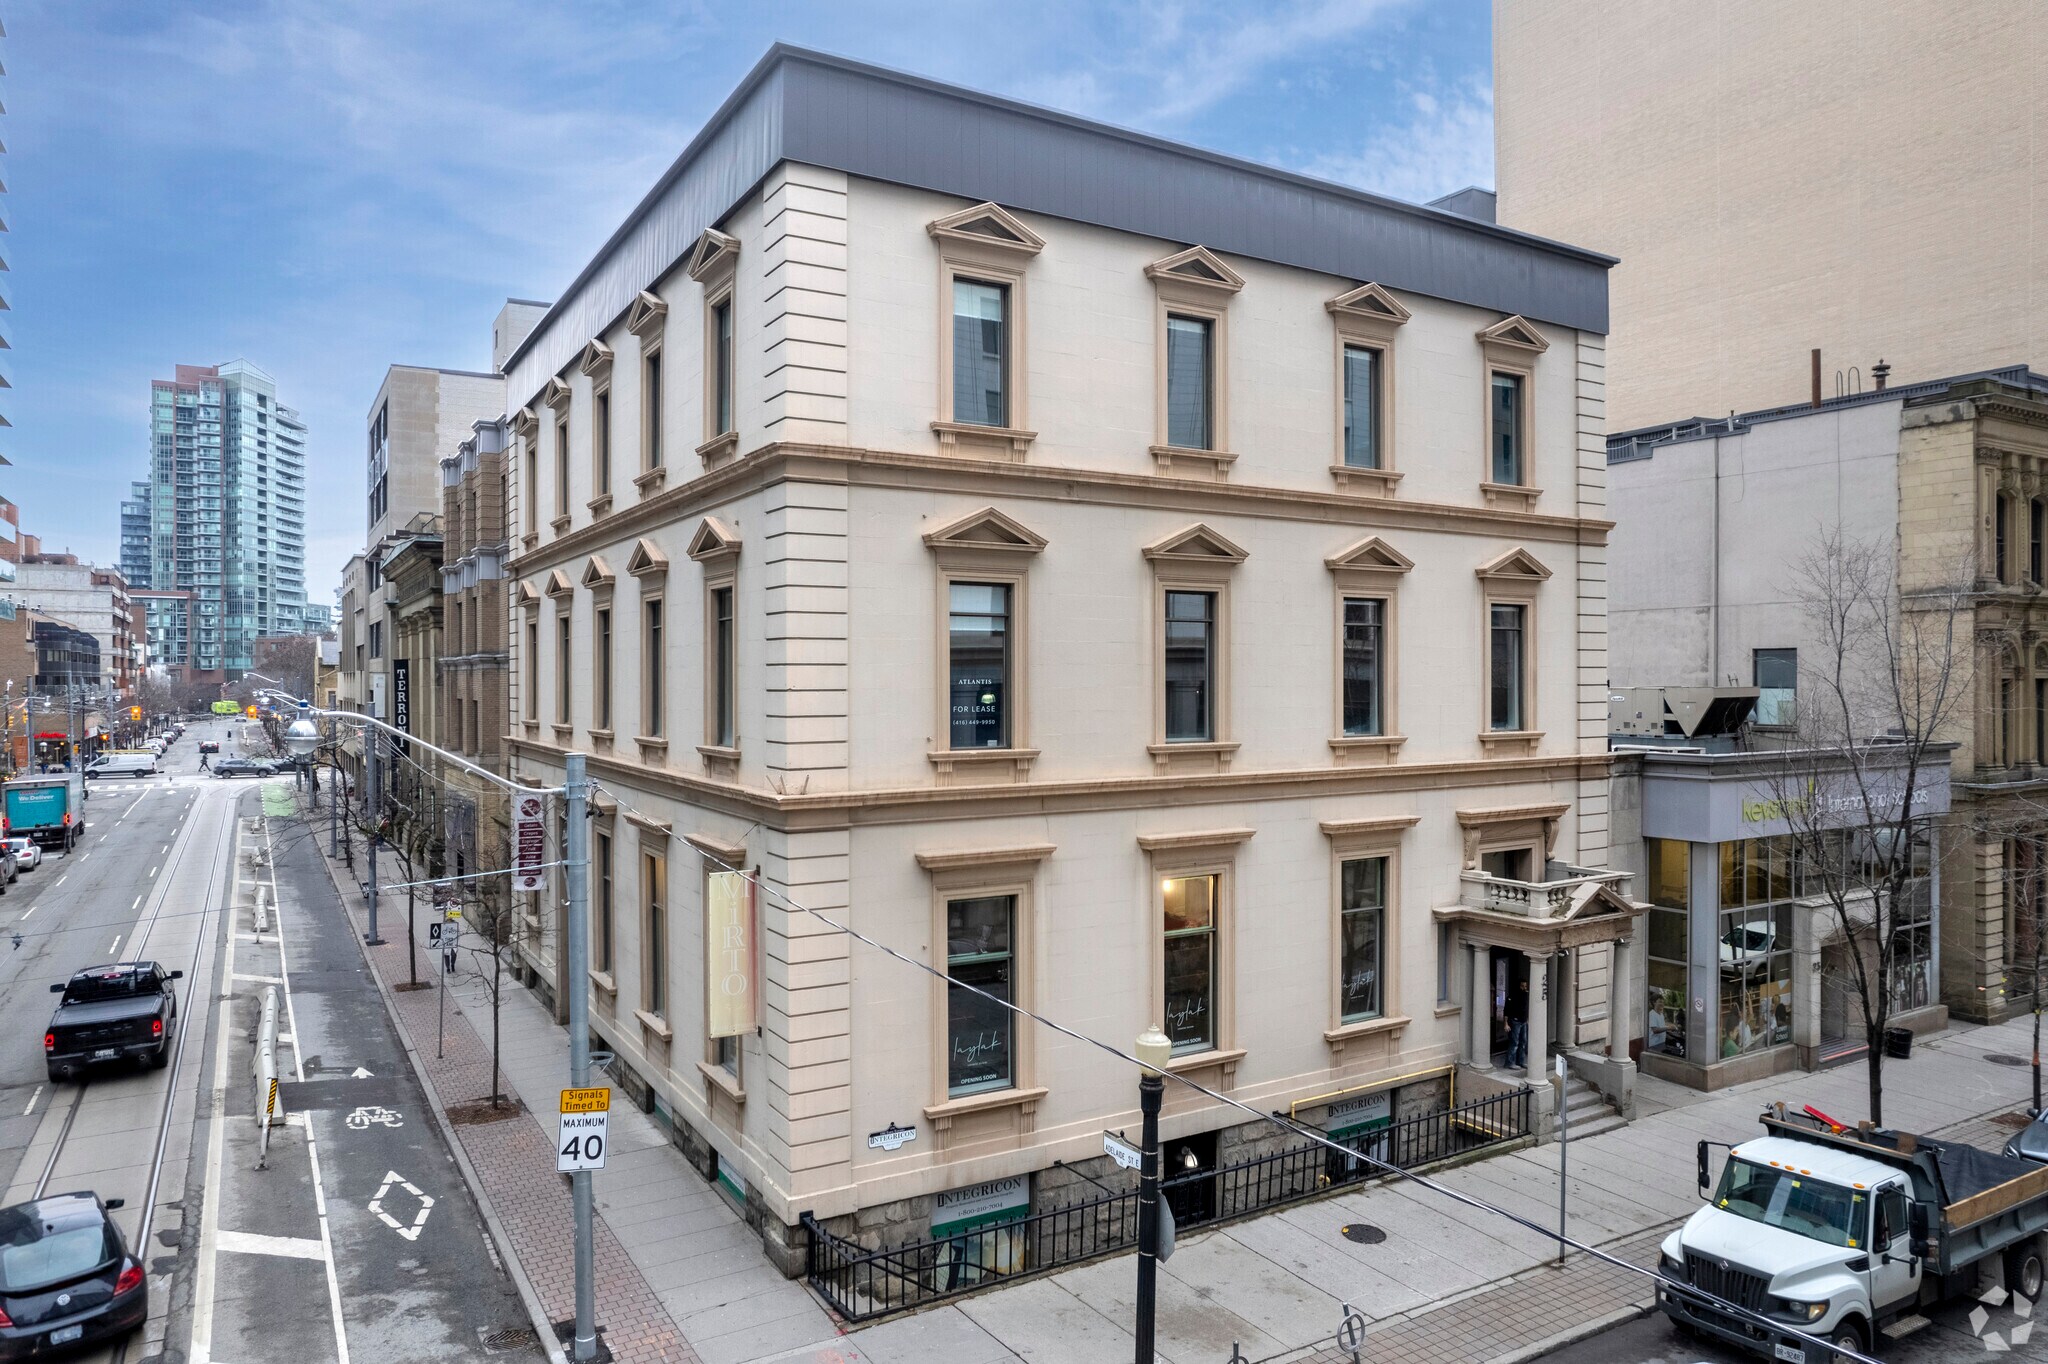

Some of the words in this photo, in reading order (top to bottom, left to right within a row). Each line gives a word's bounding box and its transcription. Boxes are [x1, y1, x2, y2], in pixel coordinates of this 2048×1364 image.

[952, 705, 969, 713] FOR
[971, 705, 996, 713] LEASE
[1189, 1036, 1202, 1044] SOON
[1775, 1032, 1789, 1042] School
[960, 1076, 983, 1085] OPENING
[982, 1073, 997, 1081] SOON
[568, 1090, 603, 1101] Signals
[564, 1101, 593, 1110] Timed
[596, 1100, 606, 1109] To
[1328, 1093, 1386, 1118] INTEGRICON
[563, 1117, 605, 1129] MAXIMUM
[870, 1130, 915, 1145] INTEGRICON
[560, 1134, 603, 1161] 40
[1105, 1144, 1126, 1161] ADELAIDE
[937, 1177, 1022, 1208] INTEGRICON
[958, 1202, 1003, 1217] 1-800-210-7004
